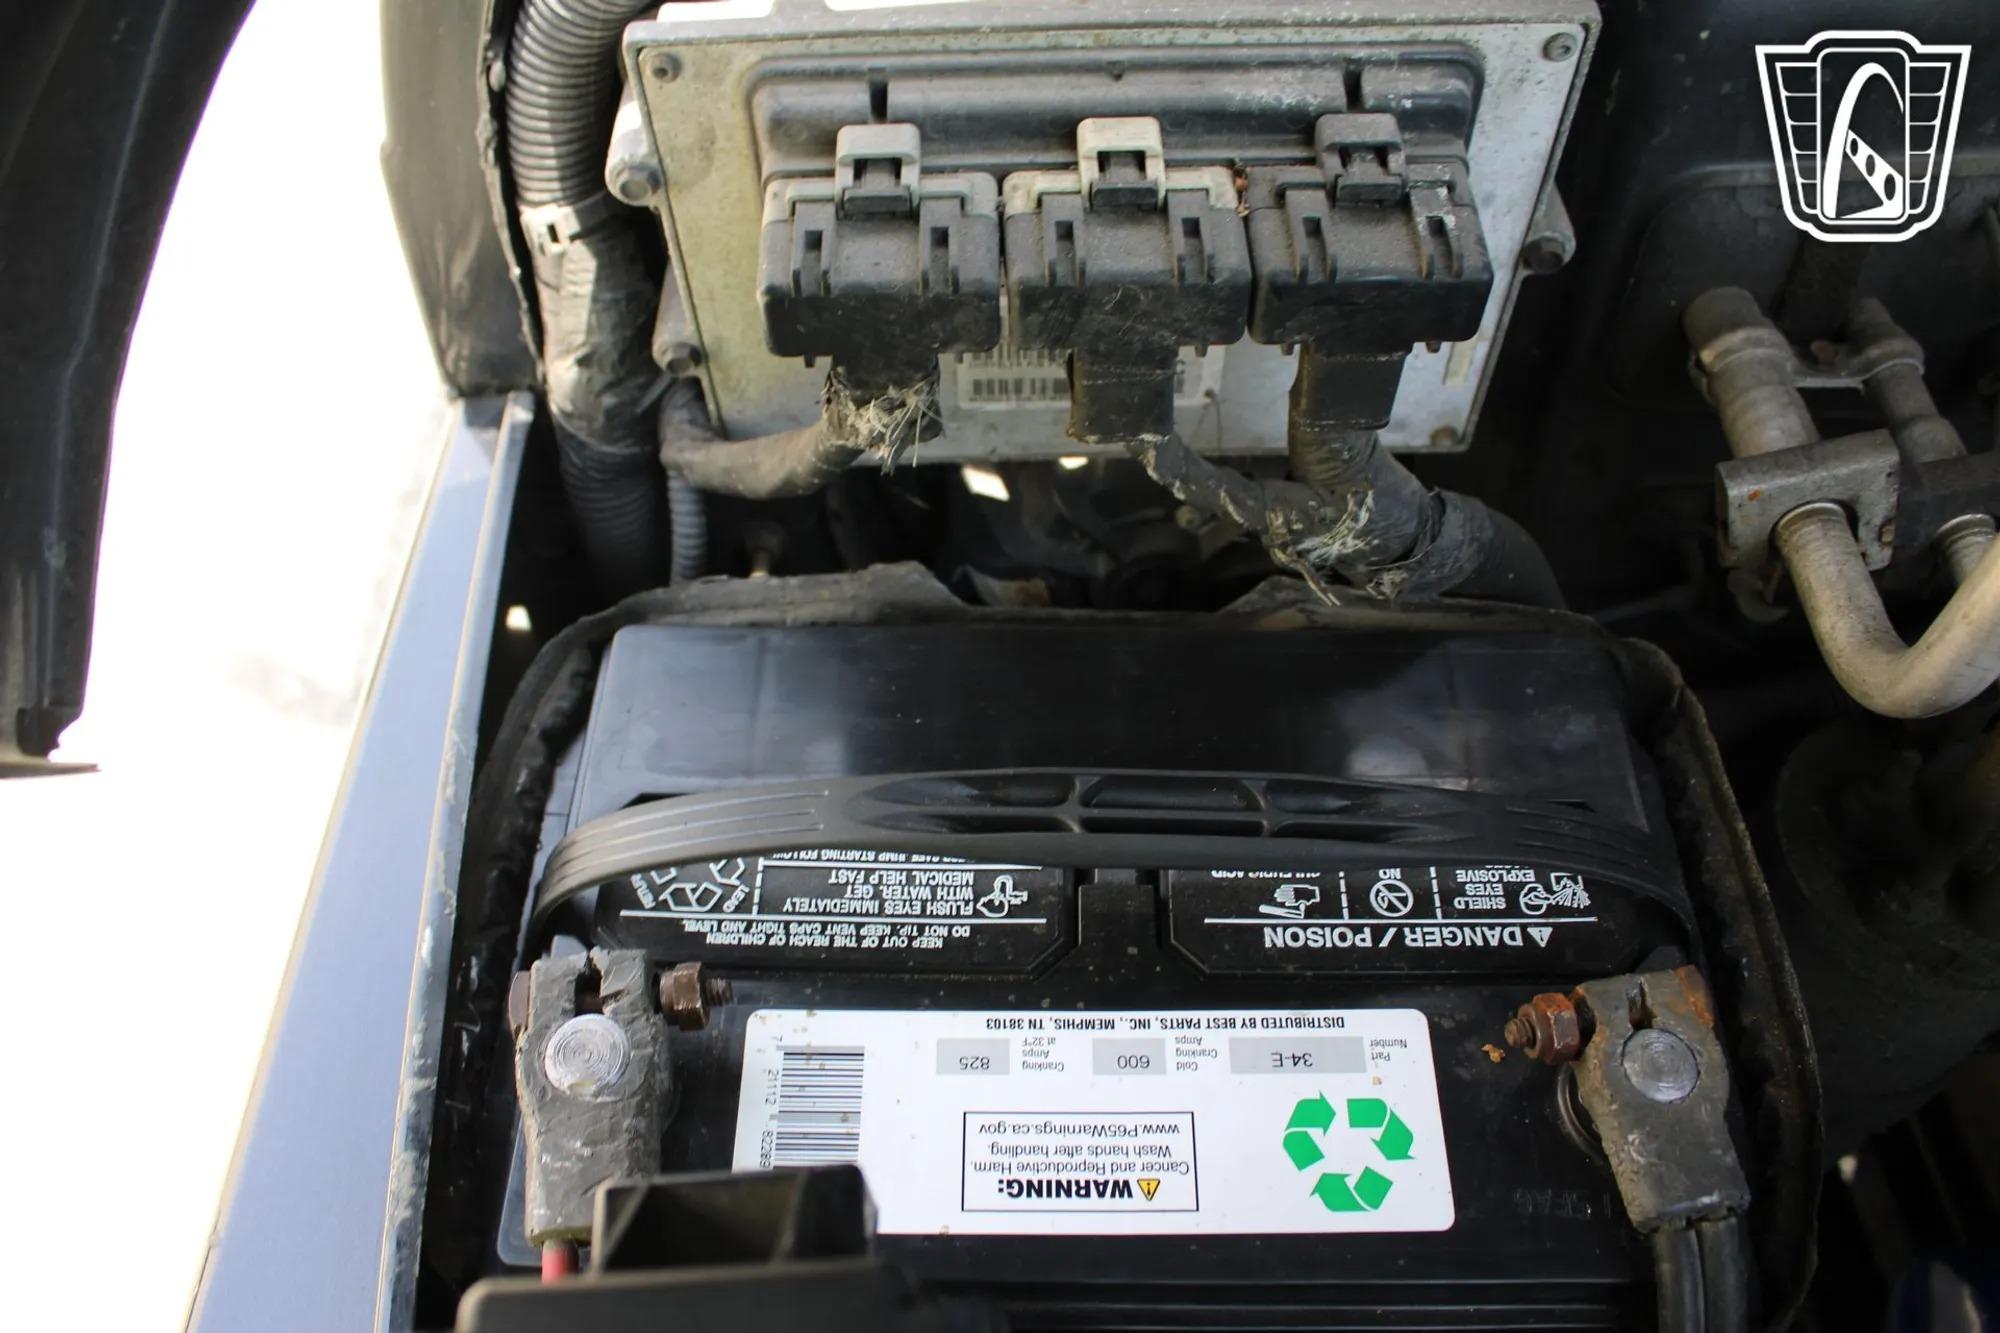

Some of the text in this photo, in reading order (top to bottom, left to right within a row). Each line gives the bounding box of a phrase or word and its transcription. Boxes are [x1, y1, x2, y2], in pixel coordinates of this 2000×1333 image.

[822, 849, 875, 861] STARTING
[829, 869, 974, 885] MEDICAL HELP FAST
[1379, 868, 1401, 879] NO
[1456, 869, 1535, 882] EXPLOSIVE
[844, 885, 974, 900] WITH WATER. GET
[1465, 883, 1504, 895] EYES
[783, 898, 974, 916] FLUSH EYES IMMEDIATELY
[1454, 897, 1506, 909] SHIELD
[721, 920, 747, 932] AND
[751, 921, 785, 933] TIGHT
[790, 922, 820, 934] CAPS
[826, 923, 856, 935] VENT
[860, 924, 891, 936] KEEP
[898, 924, 917, 936] TIP.
[922, 925, 948, 937] NOT
[953, 925, 970, 937] DO
[706, 932, 943, 948] KEEP OUT OF THE REACH OF CHILDREN
[1263, 926, 1523, 948] DANGER / POISON
[986, 1017, 1345, 1030] DISTRIBUTED BY BEST PARTS, INC., MEMPHIS, TN 38103
[1022, 1037, 1057, 1047] at 32°F
[1175, 1036, 1202, 1046] Amps
[1370, 1038, 1407, 1048] Number
[1022, 1048, 1050, 1059] Amps
[1176, 1048, 1217, 1059] Cranking
[1271, 1052, 1313, 1067] 34-E
[1371, 1051, 1390, 1061] Part
[959, 1056, 990, 1071] 825
[1022, 1060, 1064, 1071] Cranking
[1117, 1054, 1150, 1069] 600
[1176, 1061, 1198, 1071] Cold
[765, 1068, 779, 1106] 21112
[979, 1120, 1180, 1137] www.P65Warnings.ca.gov
[760, 1130, 774, 1169] 82289
[988, 1142, 1171, 1158] Wash hands after handling.
[971, 1161, 1189, 1175] Cancer and Reproductive Harm.
[999, 1179, 1133, 1198] WARNING:
